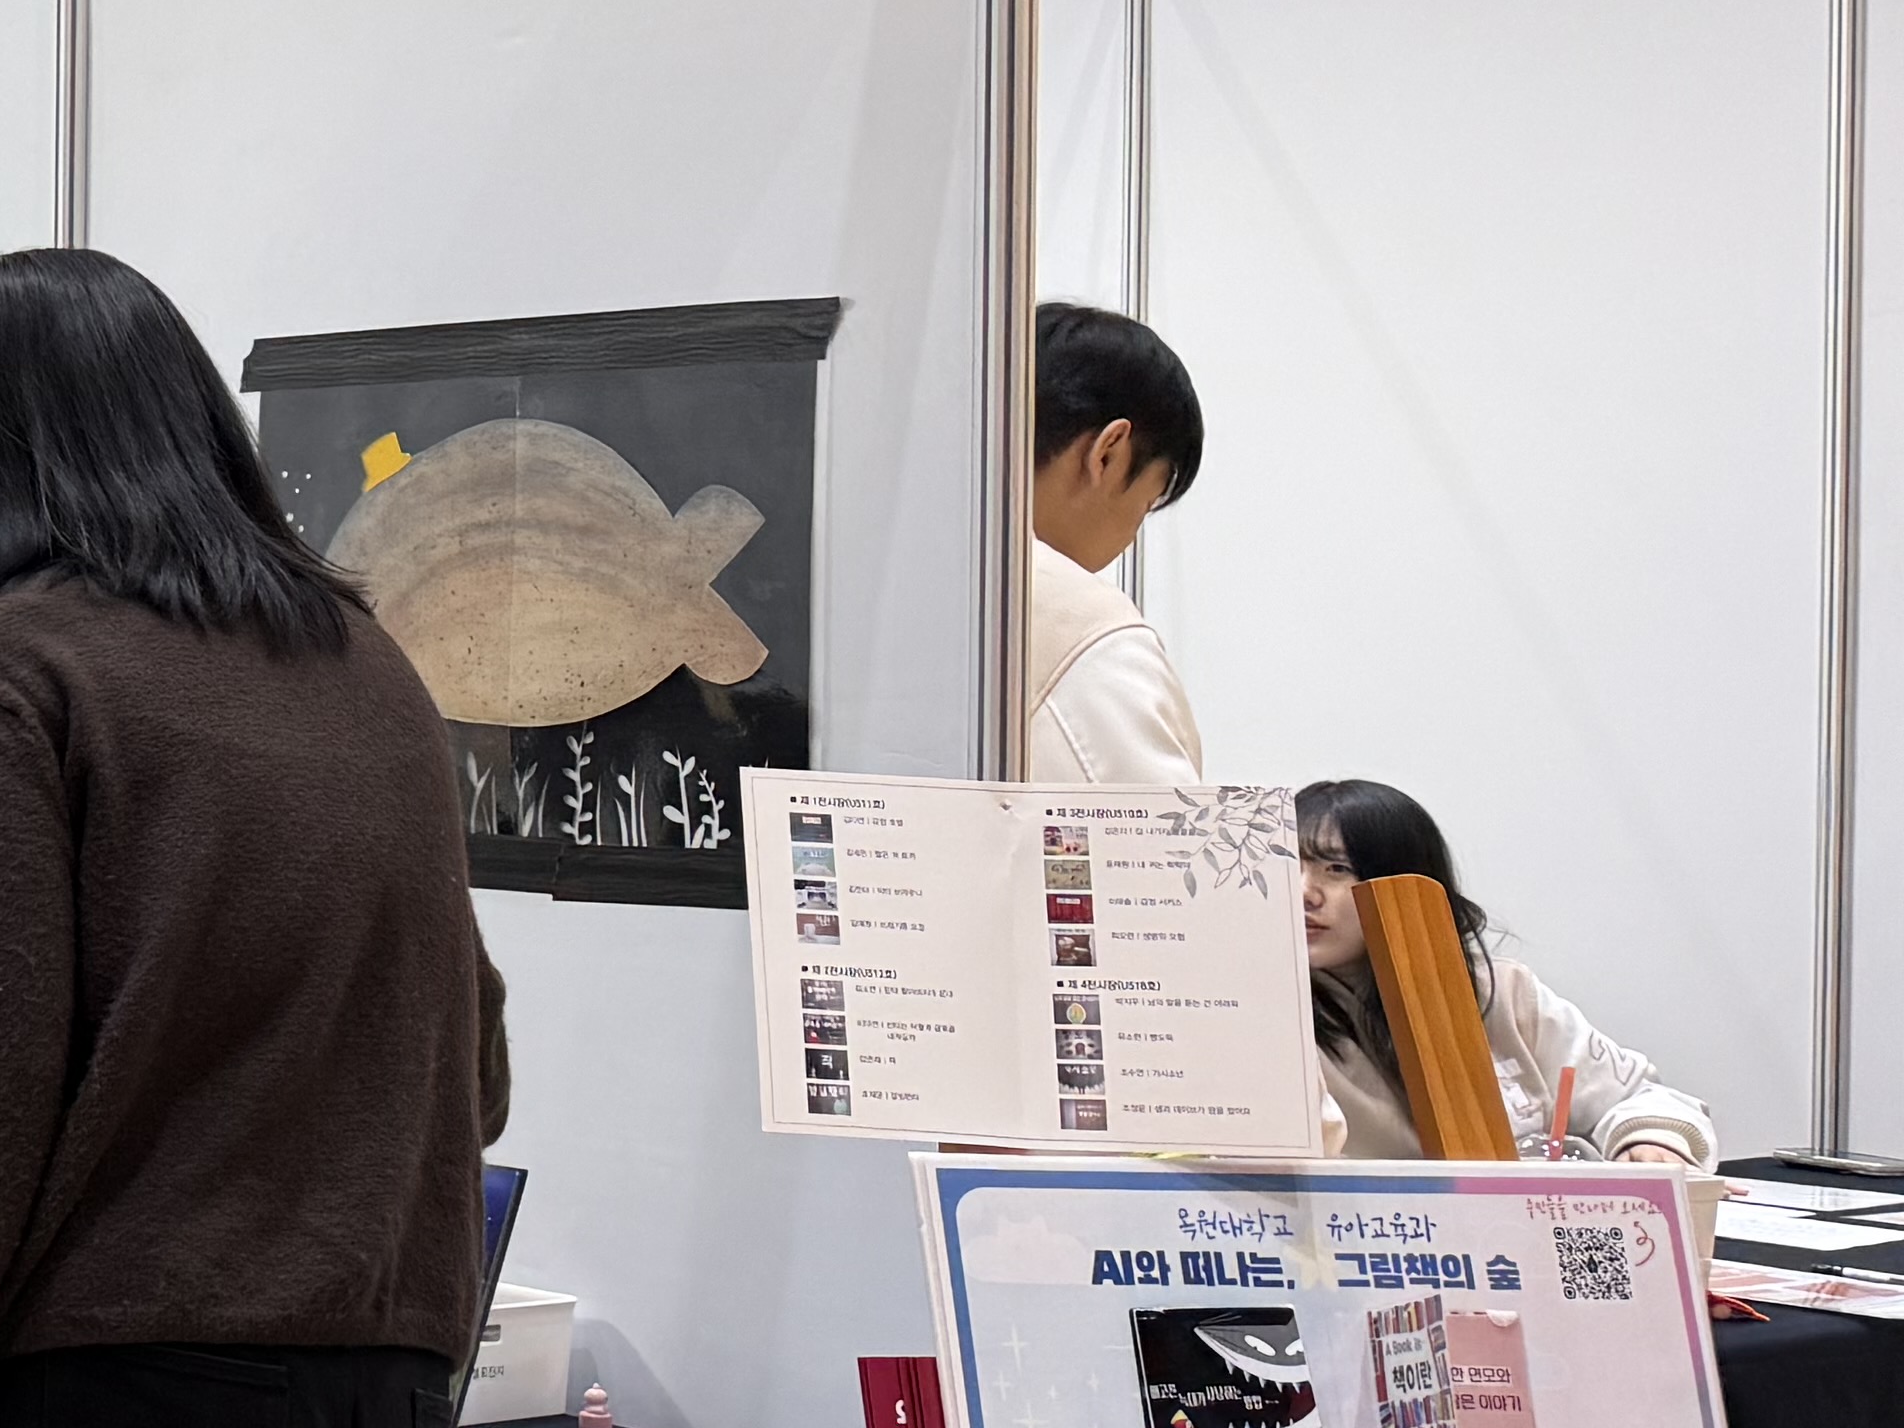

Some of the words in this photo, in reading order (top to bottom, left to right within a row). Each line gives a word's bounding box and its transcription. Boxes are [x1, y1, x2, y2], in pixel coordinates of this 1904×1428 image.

[1327, 1212, 1437, 1244] 유아교육과
[1091, 1251, 1170, 1288] AI와
[1178, 1250, 1295, 1292] 떠나는,
[1336, 1252, 1475, 1291] 그림책의
[1487, 1254, 1523, 1291] 숲
[1392, 1361, 1432, 1394] 책이란
[1479, 1394, 1522, 1412] 이야기
